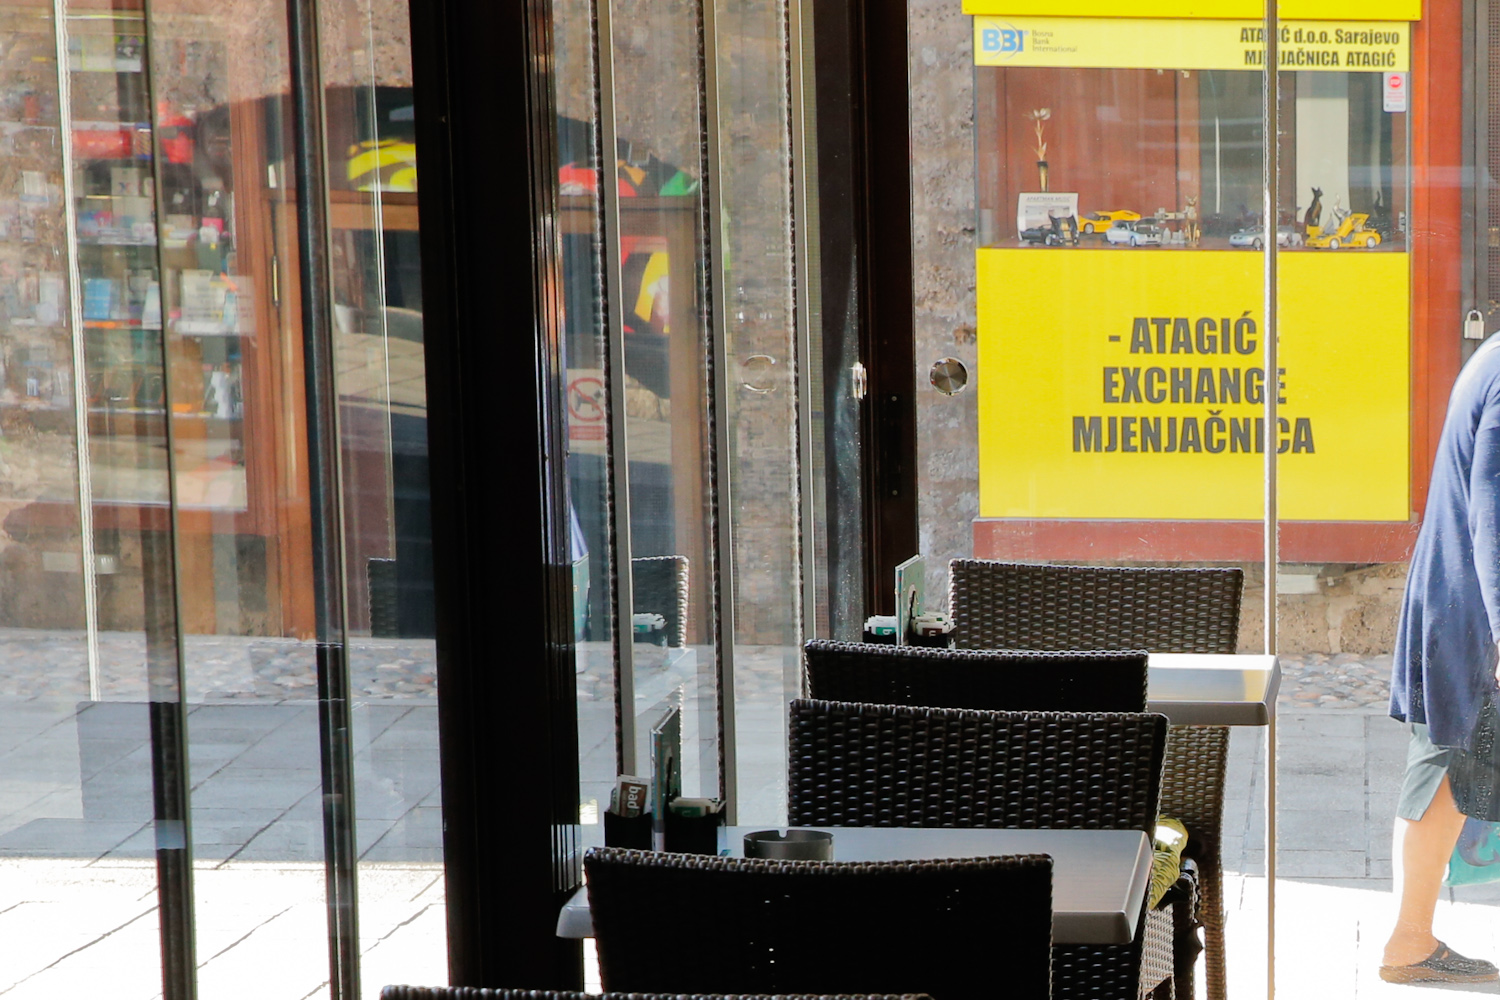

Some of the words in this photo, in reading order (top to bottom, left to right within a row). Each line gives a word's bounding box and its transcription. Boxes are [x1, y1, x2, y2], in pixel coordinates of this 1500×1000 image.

[982, 29, 1023, 52] BBI
[1032, 29, 1053, 37] Bosna
[1294, 28, 1332, 44] d.o.o.
[1335, 28, 1399, 45] Sarajevo
[1244, 48, 1340, 66] MJJAČNICA
[1346, 49, 1396, 67] ATAGIĆ
[1129, 311, 1257, 355] ATAGIĆ
[1103, 366, 1287, 405] EXCHANGE
[1072, 409, 1316, 454] MJENJAČNICA
